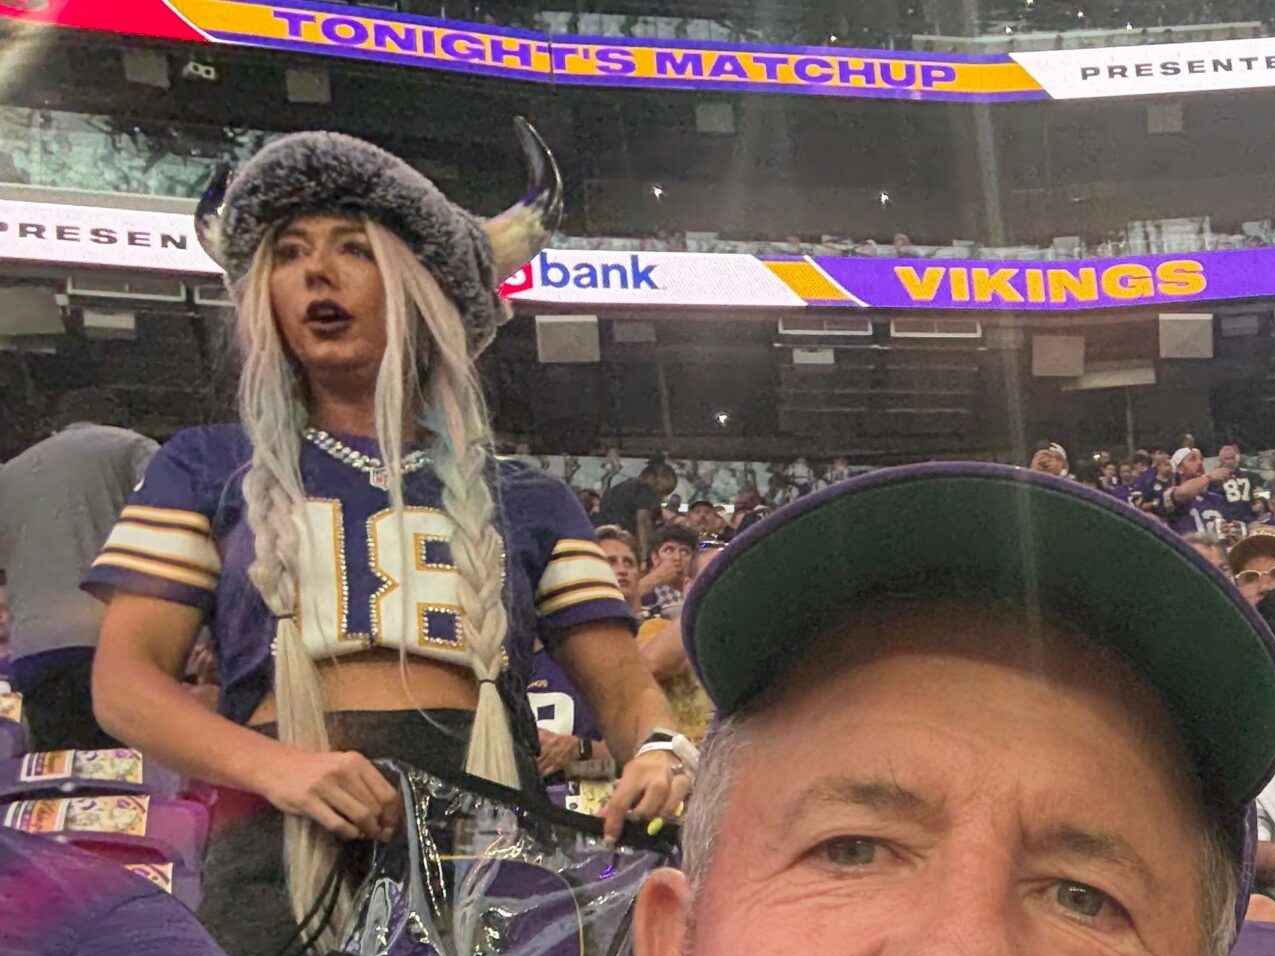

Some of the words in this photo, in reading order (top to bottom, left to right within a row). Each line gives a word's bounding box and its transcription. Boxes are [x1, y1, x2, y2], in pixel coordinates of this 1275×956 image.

[272, 10, 635, 76] TONIGHT'S
[654, 50, 956, 91] MATCHUP
[0, 222, 188, 250] RESEN
[540, 251, 660, 290] bank
[894, 262, 1209, 304] VIKINGS
[1223, 478, 1250, 502] 87
